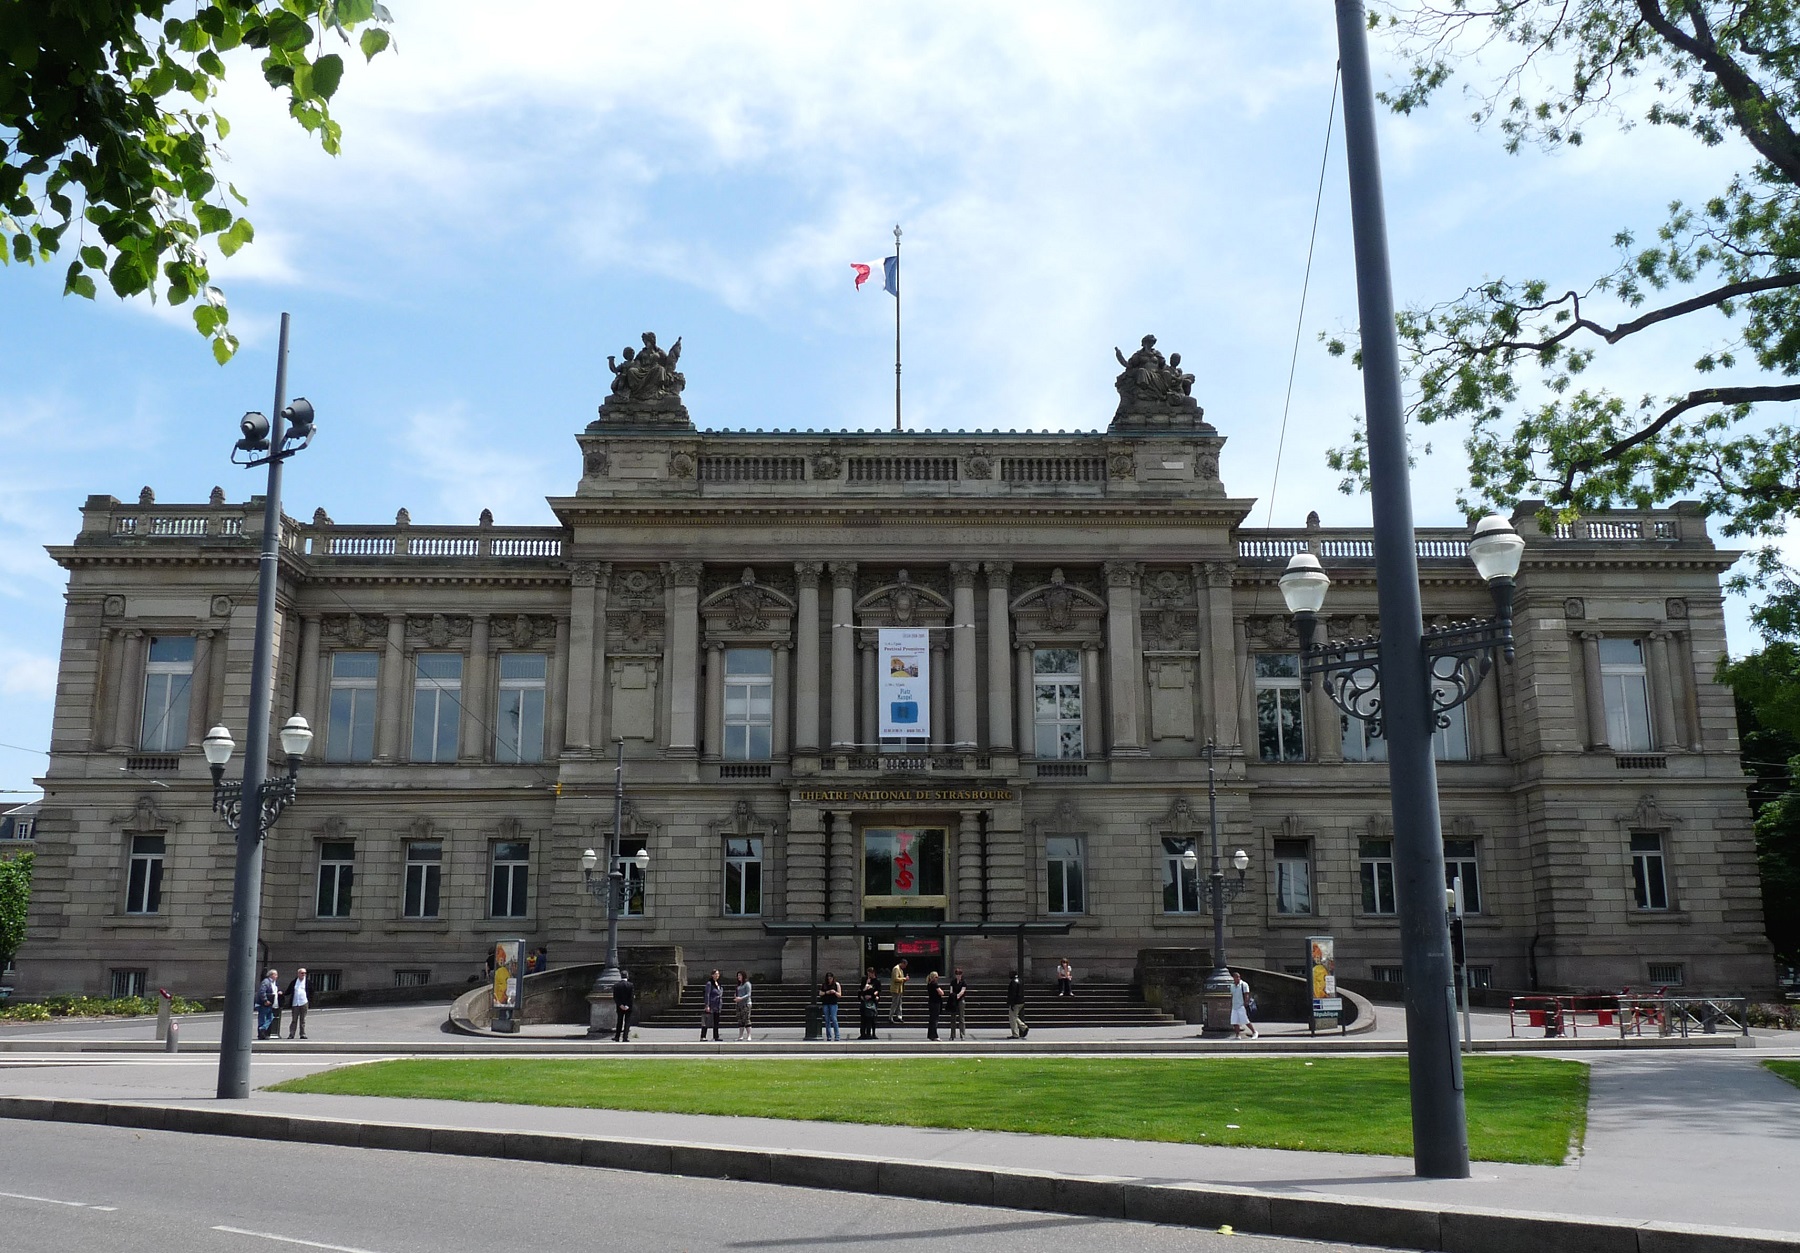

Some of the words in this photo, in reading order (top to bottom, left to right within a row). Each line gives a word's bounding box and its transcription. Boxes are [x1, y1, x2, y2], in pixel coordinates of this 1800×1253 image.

[800, 790, 849, 800] THEATRE
[853, 790, 912, 800] NATIONAL
[916, 790, 931, 800] DE
[935, 790, 1012, 800] STRASBOURG
